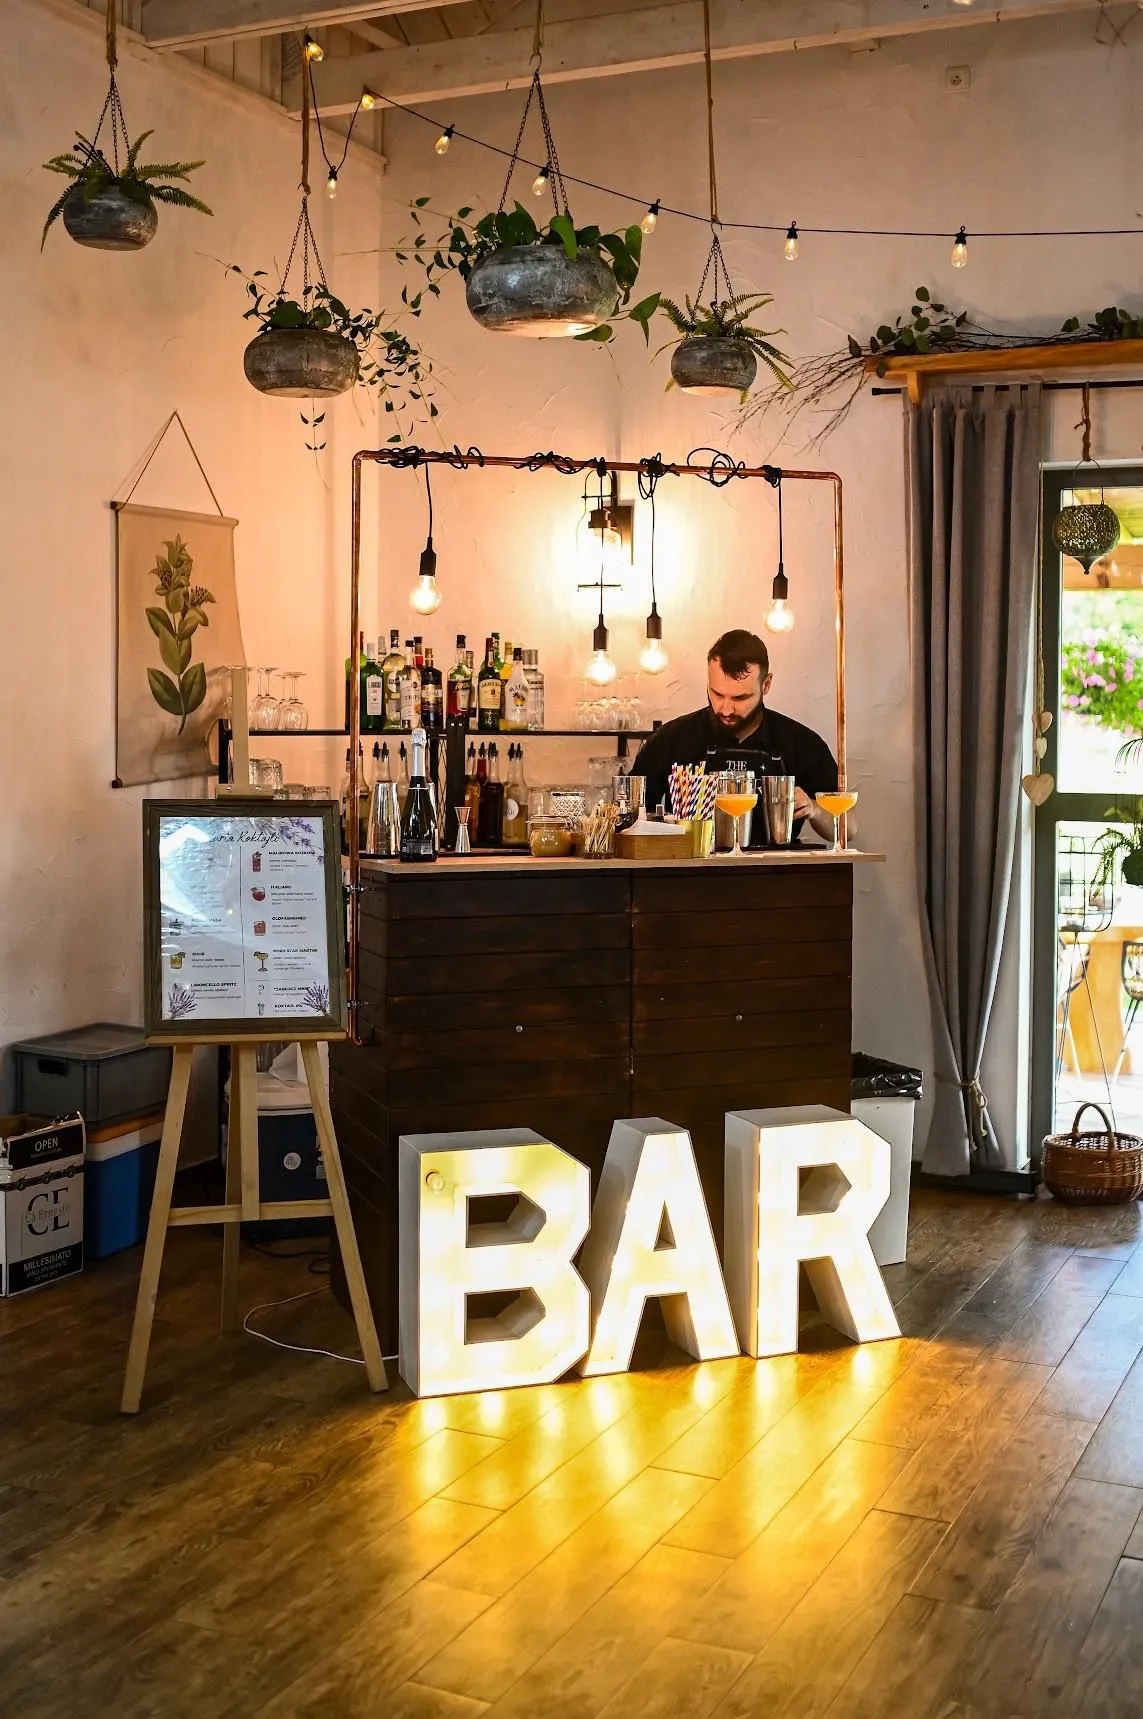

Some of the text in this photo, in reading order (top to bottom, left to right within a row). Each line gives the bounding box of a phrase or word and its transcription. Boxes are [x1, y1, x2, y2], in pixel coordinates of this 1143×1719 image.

[726, 760, 748, 771] THE
[209, 831, 235, 843] arta
[34, 1137, 59, 1152] OPEN
[27, 1187, 69, 1236] CE
[23, 1249, 71, 1272] MILLESIMATO
[399, 1105, 902, 1397] BAR
